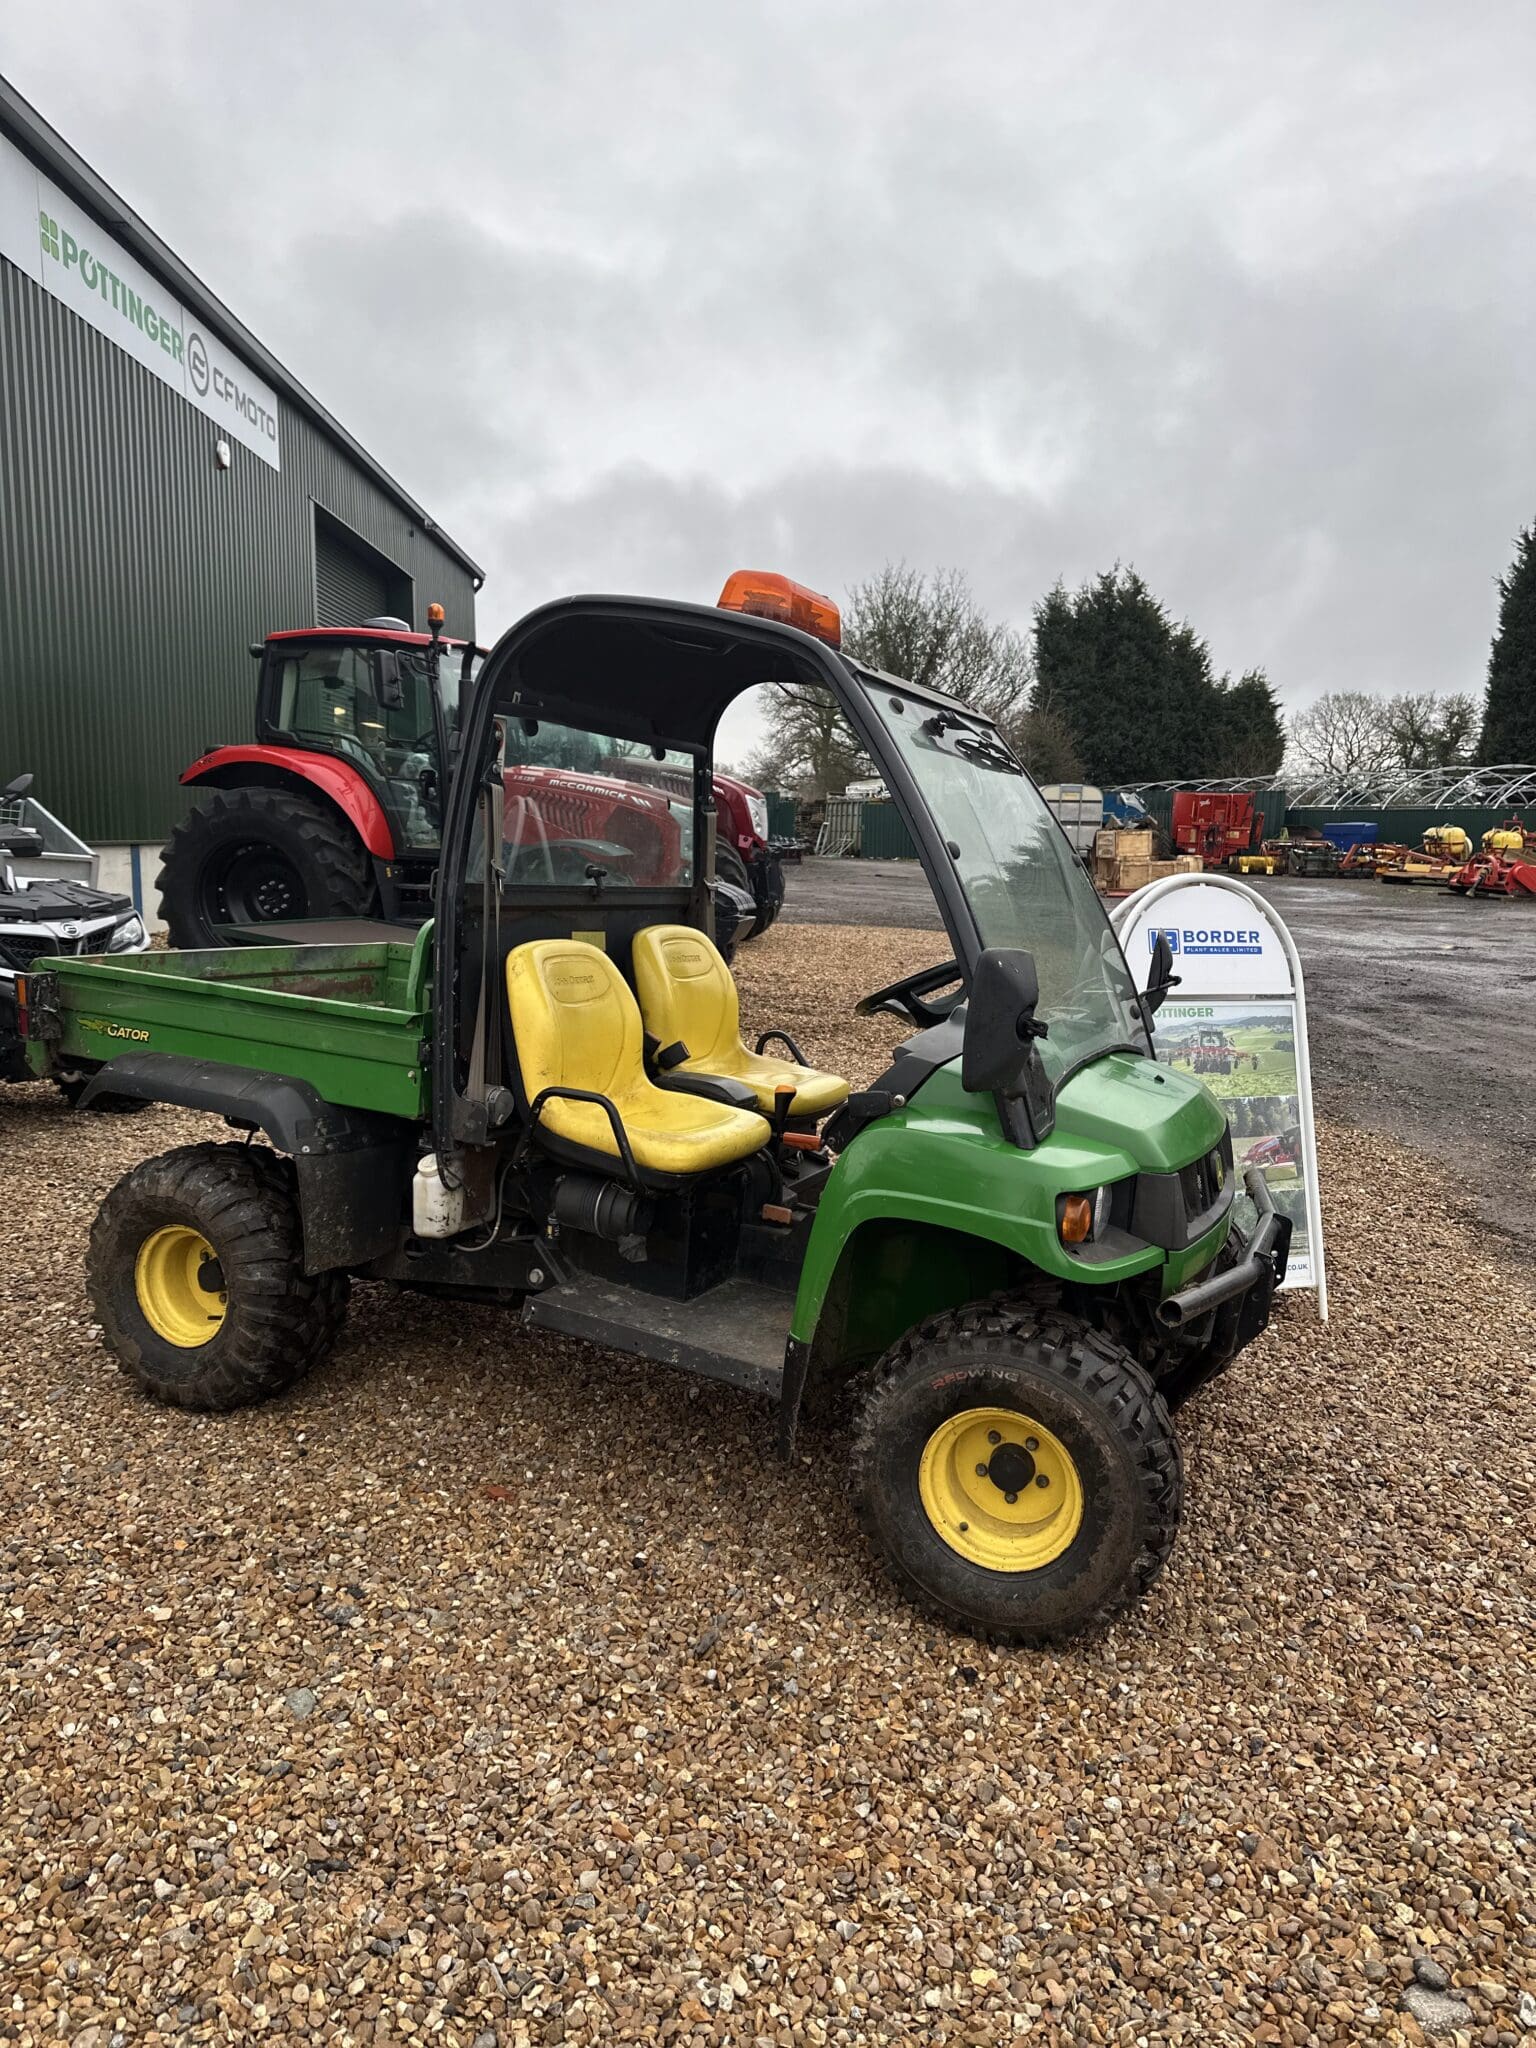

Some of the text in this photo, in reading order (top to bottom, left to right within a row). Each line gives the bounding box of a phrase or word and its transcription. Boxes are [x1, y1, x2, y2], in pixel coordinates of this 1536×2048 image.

[213, 366, 276, 442] CFMOTO
[1183, 930, 1260, 943] BORDER
[107, 1023, 150, 1042] GATOR
